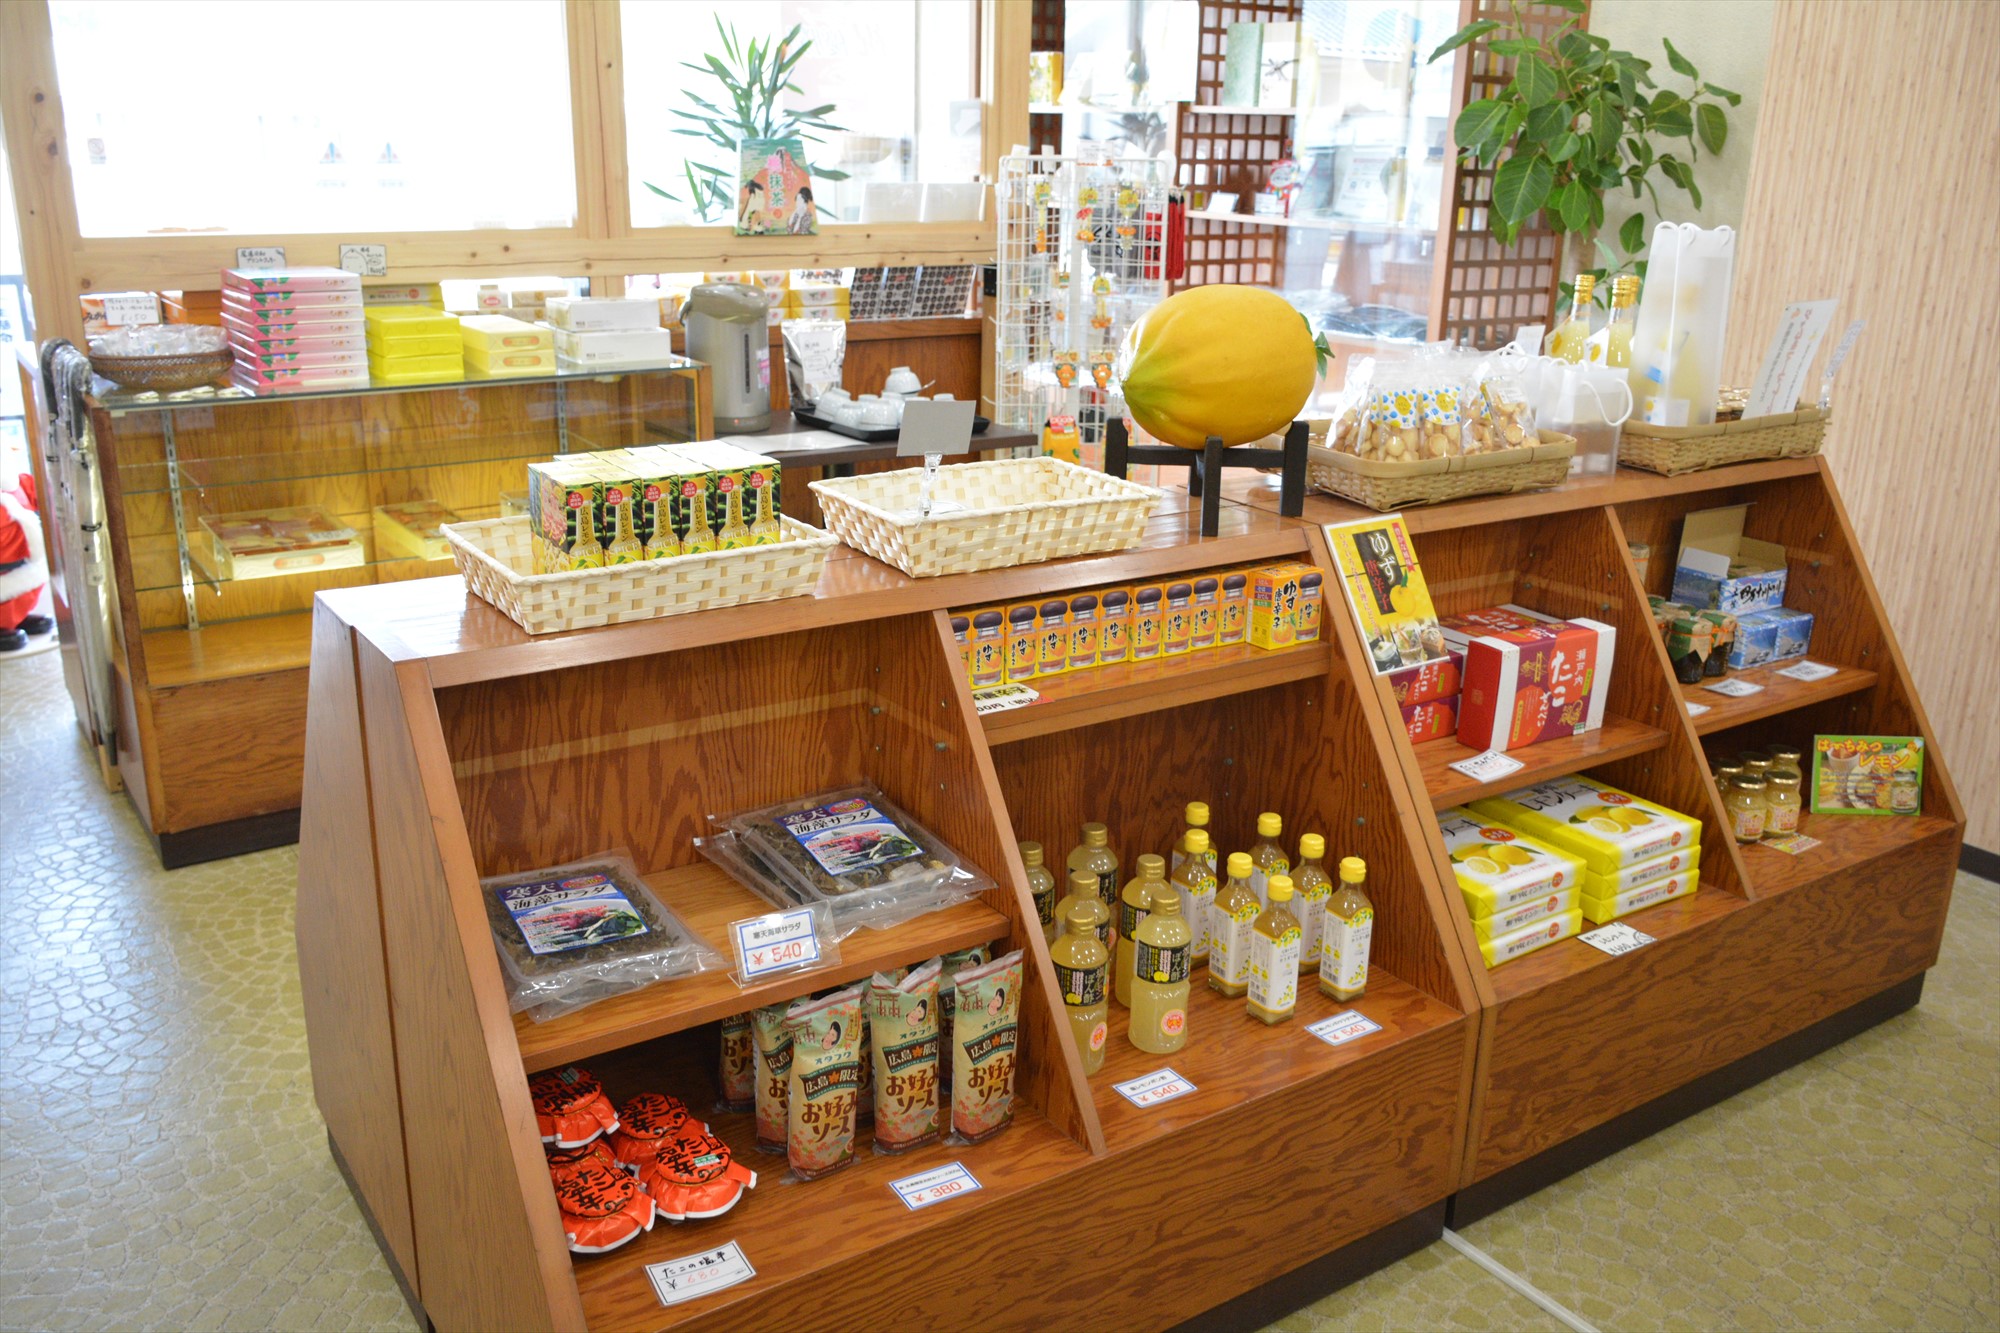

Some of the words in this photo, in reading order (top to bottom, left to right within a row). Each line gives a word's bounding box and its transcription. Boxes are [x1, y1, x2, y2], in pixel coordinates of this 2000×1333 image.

[1368, 532, 1397, 586] ゆず
[1283, 580, 1297, 610] ゆず
[1365, 559, 1390, 612] 唐辛子
[1200, 608, 1209, 625] ゆず
[1229, 604, 1237, 620] ゆず
[1273, 588, 1282, 628] 唐辛子
[1110, 622, 1118, 639] ゆず
[1143, 618, 1152, 635] ゆず
[1173, 614, 1182, 631] ゆず
[1048, 632, 1057, 650] ゆず
[1078, 627, 1087, 644] ゆず
[983, 644, 993, 662] ゆず
[1018, 638, 1027, 656] ゆず
[1574, 648, 1587, 687] 瀬戸内
[1419, 664, 1431, 692] たこ
[1551, 650, 1573, 708] たこ
[1537, 690, 1552, 728] せんべい
[1414, 705, 1426, 734] たこ
[1859, 752, 1911, 769] レモン
[784, 808, 827, 825] 寒天
[795, 809, 871, 834] 海藻サラダ
[505, 882, 557, 899] 寒天
[513, 884, 609, 910] 海藻サラダ
[753, 922, 801, 940] 寒天海草サラダ
[771, 942, 802, 963] 540
[900, 1025, 932, 1040] オタフク
[982, 1014, 1010, 1031] オタフク
[1340, 1024, 1367, 1036] 540
[970, 1040, 993, 1060] 広島
[1000, 1030, 1016, 1047] 限定
[768, 1051, 790, 1070] 広島
[814, 1051, 852, 1066] オタフク
[887, 1048, 913, 1068] 広島
[805, 1076, 829, 1094] 広島
[839, 1067, 858, 1082] 限定
[886, 1062, 938, 1097] お好み
[968, 1053, 1016, 1089] お好み
[978, 1077, 1011, 1106] ソース
[1151, 1084, 1180, 1099] 540
[801, 1090, 857, 1125] お好み
[897, 1088, 935, 1116] ソース
[812, 1115, 851, 1144] ソース
[930, 1181, 962, 1198] 380
[666, 1278, 678, 1290] ¥
[687, 1267, 720, 1285] 680
